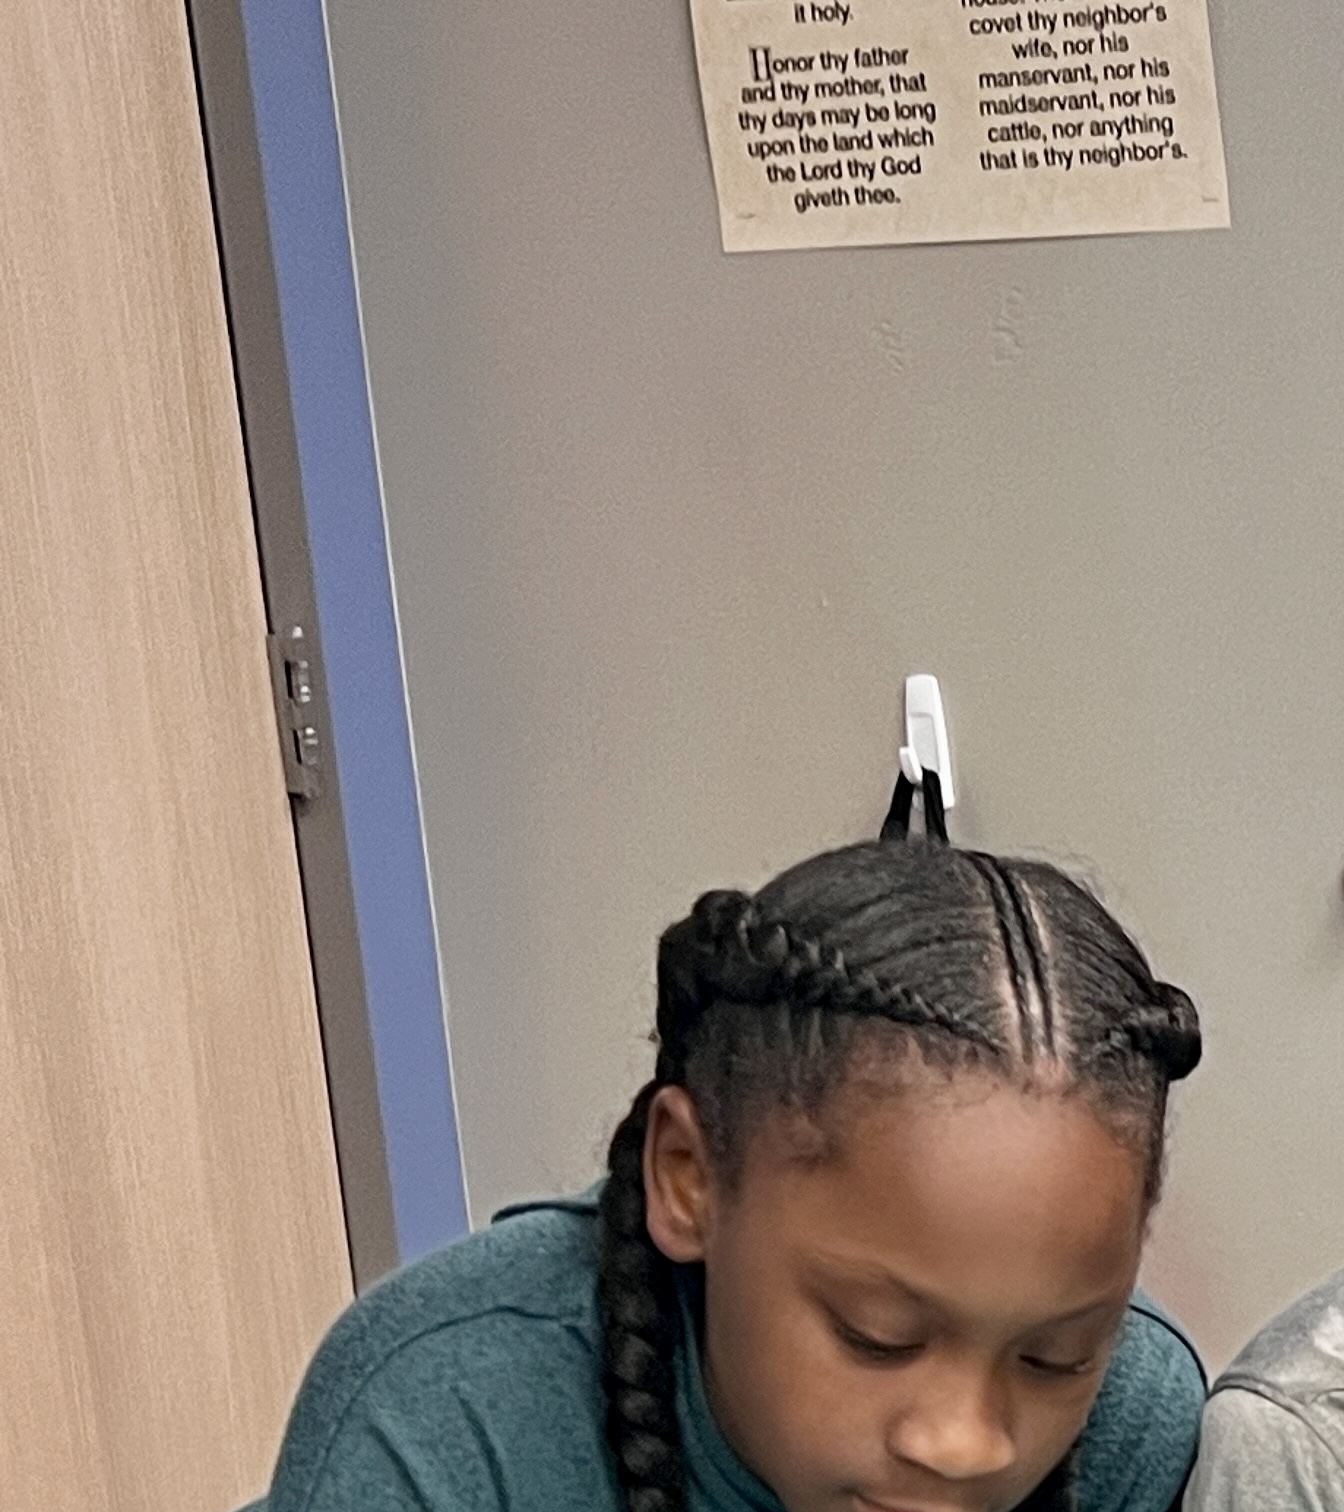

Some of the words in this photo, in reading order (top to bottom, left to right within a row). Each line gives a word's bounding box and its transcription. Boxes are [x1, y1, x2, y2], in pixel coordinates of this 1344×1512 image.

[811, 1, 854, 26] holy.
[969, 12, 1022, 35] covet
[1027, 9, 1058, 34] thy
[1063, 2, 1168, 31] neighbor's
[1011, 38, 1058, 59] wife,
[1062, 37, 1095, 55] nor
[1100, 30, 1130, 53] his
[748, 46, 815, 82] Honor
[820, 50, 849, 74] thy
[854, 46, 909, 68] father
[978, 63, 1099, 89] manservant,
[1103, 62, 1136, 81] nor
[1140, 56, 1170, 78] his
[741, 79, 776, 104] and
[780, 80, 809, 105] thy
[814, 75, 885, 98] mother,
[889, 72, 927, 94] that
[979, 90, 1105, 116] maidservant,
[1109, 89, 1142, 109] nor
[1146, 84, 1176, 105] his
[738, 110, 767, 134] thy
[772, 108, 816, 132] days
[821, 107, 860, 129] may
[865, 102, 890, 123] be
[894, 100, 936, 124] long
[987, 121, 1048, 143] cattle,
[1052, 120, 1084, 140] nor
[1089, 112, 1175, 140] anything
[747, 138, 796, 161] upon
[799, 134, 829, 154] the
[833, 130, 873, 152] land
[878, 126, 934, 149] which
[979, 148, 1017, 171] that
[1022, 147, 1039, 168] is
[1043, 145, 1074, 171] thy
[1079, 140, 1188, 168] neighbor's.
[766, 164, 796, 183] the
[800, 159, 843, 181] Lord
[848, 158, 876, 182] thy
[881, 154, 922, 176] God
[794, 187, 850, 214] giveth
[854, 185, 901, 205] thee.
